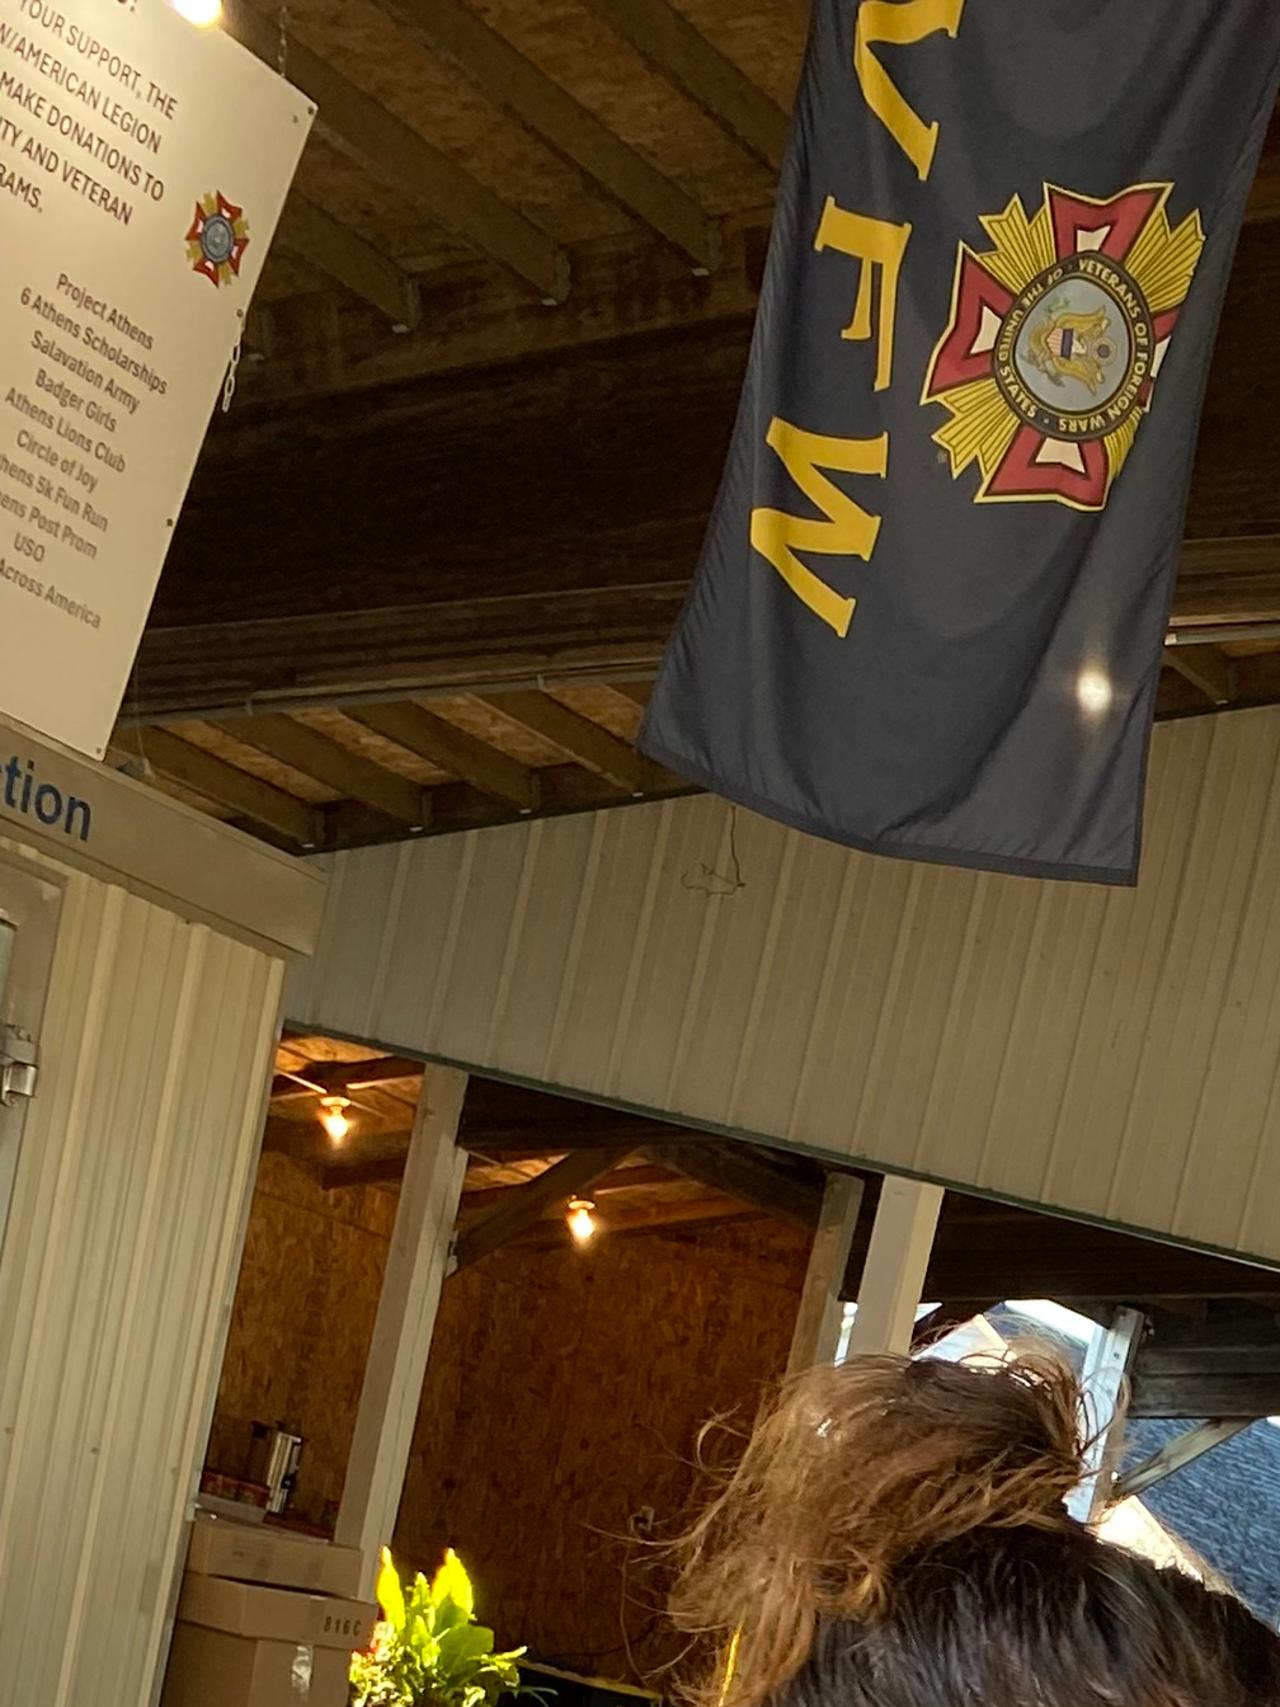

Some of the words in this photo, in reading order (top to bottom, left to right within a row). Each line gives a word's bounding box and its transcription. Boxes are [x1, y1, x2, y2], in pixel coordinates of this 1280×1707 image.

[67, 24, 142, 99] SUPPORT,
[146, 82, 178, 120] THE
[0, 71, 47, 119] MAKE
[47, 105, 141, 187] DONATIONS
[143, 172, 164, 201] TO
[101, 97, 161, 154] LEGION
[22, 137, 60, 173] AND
[62, 160, 133, 225] VETERAN
[56, 273, 107, 320] Project
[107, 308, 154, 351] Athens
[750, 0, 965, 639] VFW
[1079, 259, 1142, 319] VETERANS
[20, 287, 31, 305] 6
[31, 295, 81, 338] Athens
[82, 326, 168, 394] Scholarships
[998, 310, 1024, 361] UNITED
[1134, 323, 1148, 346] OF
[31, 330, 104, 389] Salavation
[104, 378, 140, 415] Army
[35, 368, 84, 408] Badger
[85, 400, 117, 432] Girls
[999, 366, 1038, 418] STATES
[1108, 352, 1148, 420] FOREIGN
[4, 388, 54, 430] Athens
[56, 417, 93, 453] Lions
[94, 441, 126, 473] Club
[1059, 416, 1106, 433] WARS
[16, 429, 59, 466] Circle
[61, 458, 76, 475] of
[76, 463, 99, 493] Joy
[28, 506, 61, 538] Post
[61, 525, 98, 559] Prom
[54, 487, 80, 515] Fun
[82, 502, 109, 532] Run
[13, 532, 45, 562] USO
[44, 585, 101, 629] America
